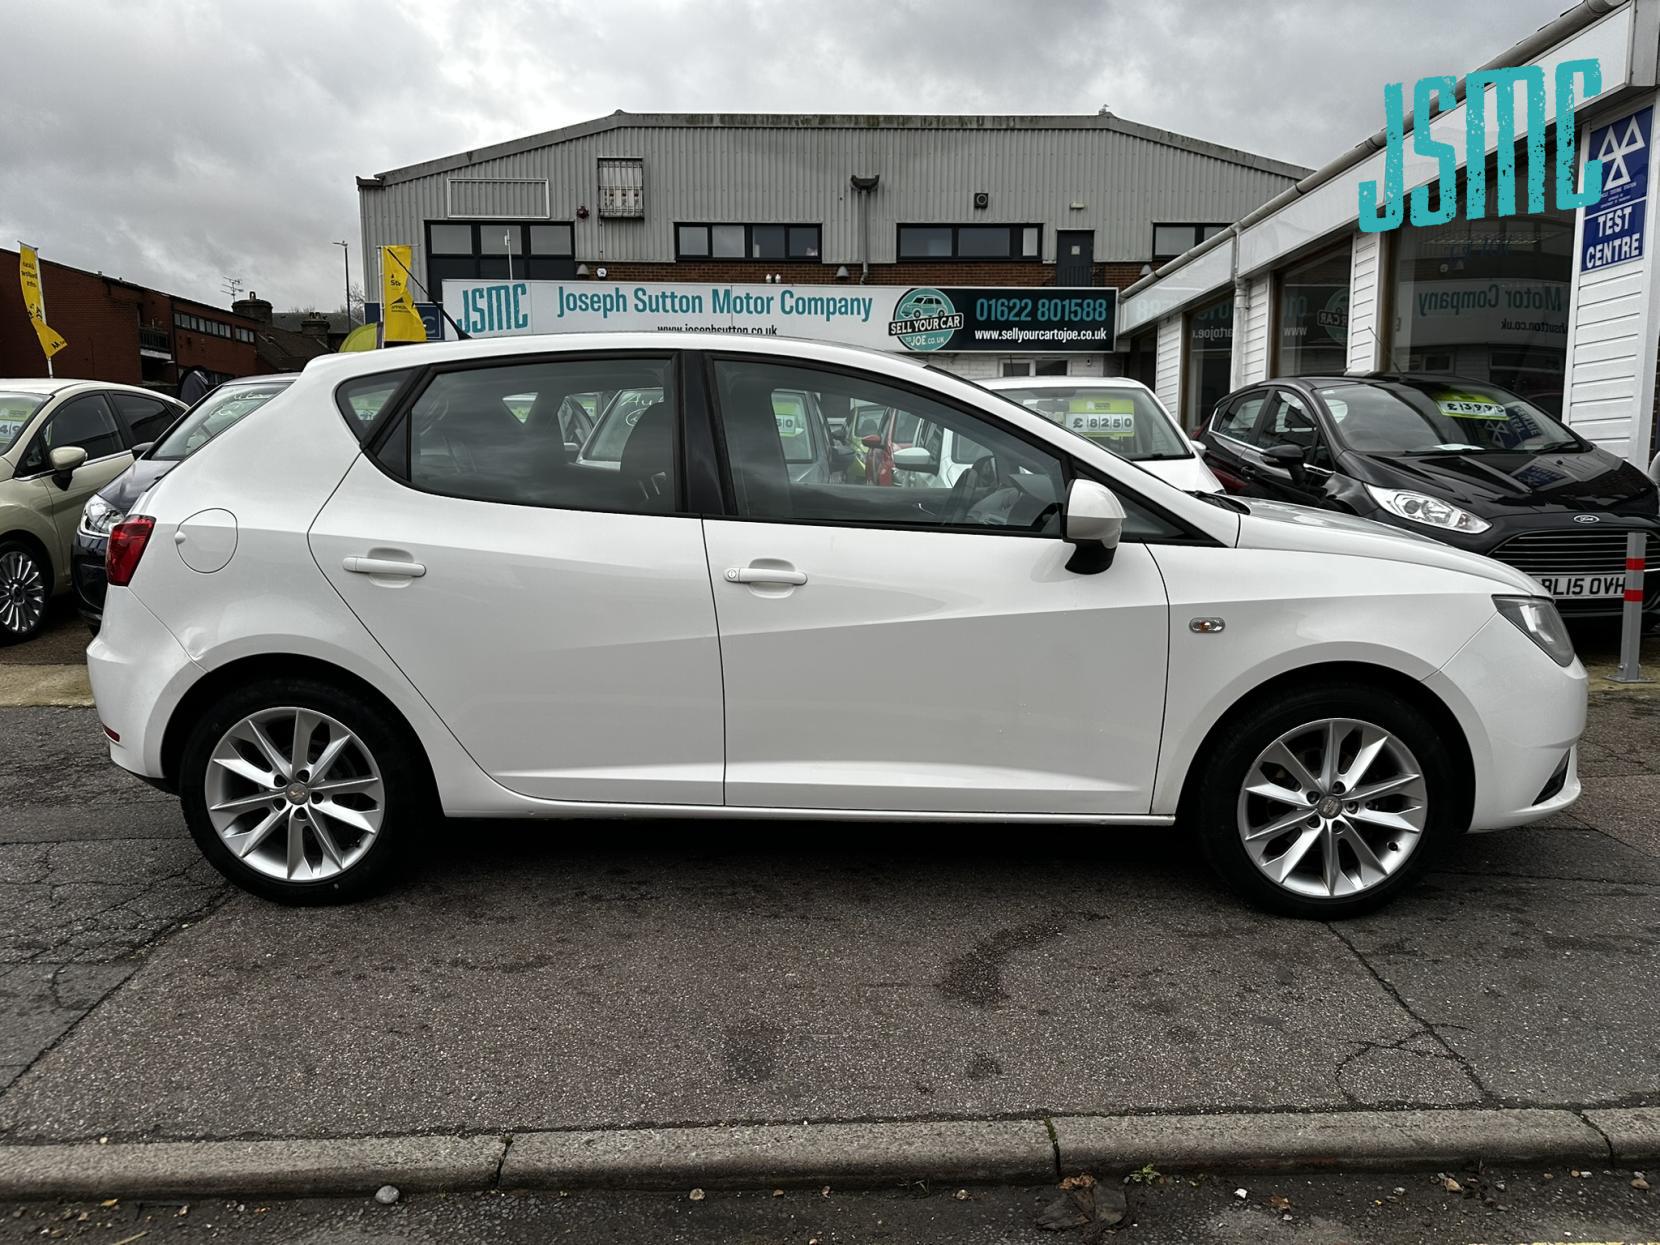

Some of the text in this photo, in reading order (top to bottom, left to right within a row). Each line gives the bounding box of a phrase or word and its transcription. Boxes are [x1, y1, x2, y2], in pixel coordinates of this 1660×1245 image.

[1598, 206, 1632, 238] TEST
[1586, 233, 1640, 269] CENTRE
[456, 283, 528, 334] JSMC
[557, 286, 872, 323] Joseph Sutton Motor Company
[976, 298, 1107, 322] 01622 801588
[657, 323, 778, 336] wwwjosephsuttoncouk
[890, 315, 960, 334] SELL YOUR CAR
[911, 335, 927, 346] JOE
[974, 327, 1107, 344] www.sellyourcartojoe.co.uk
[1589, 577, 1625, 595] OVH
